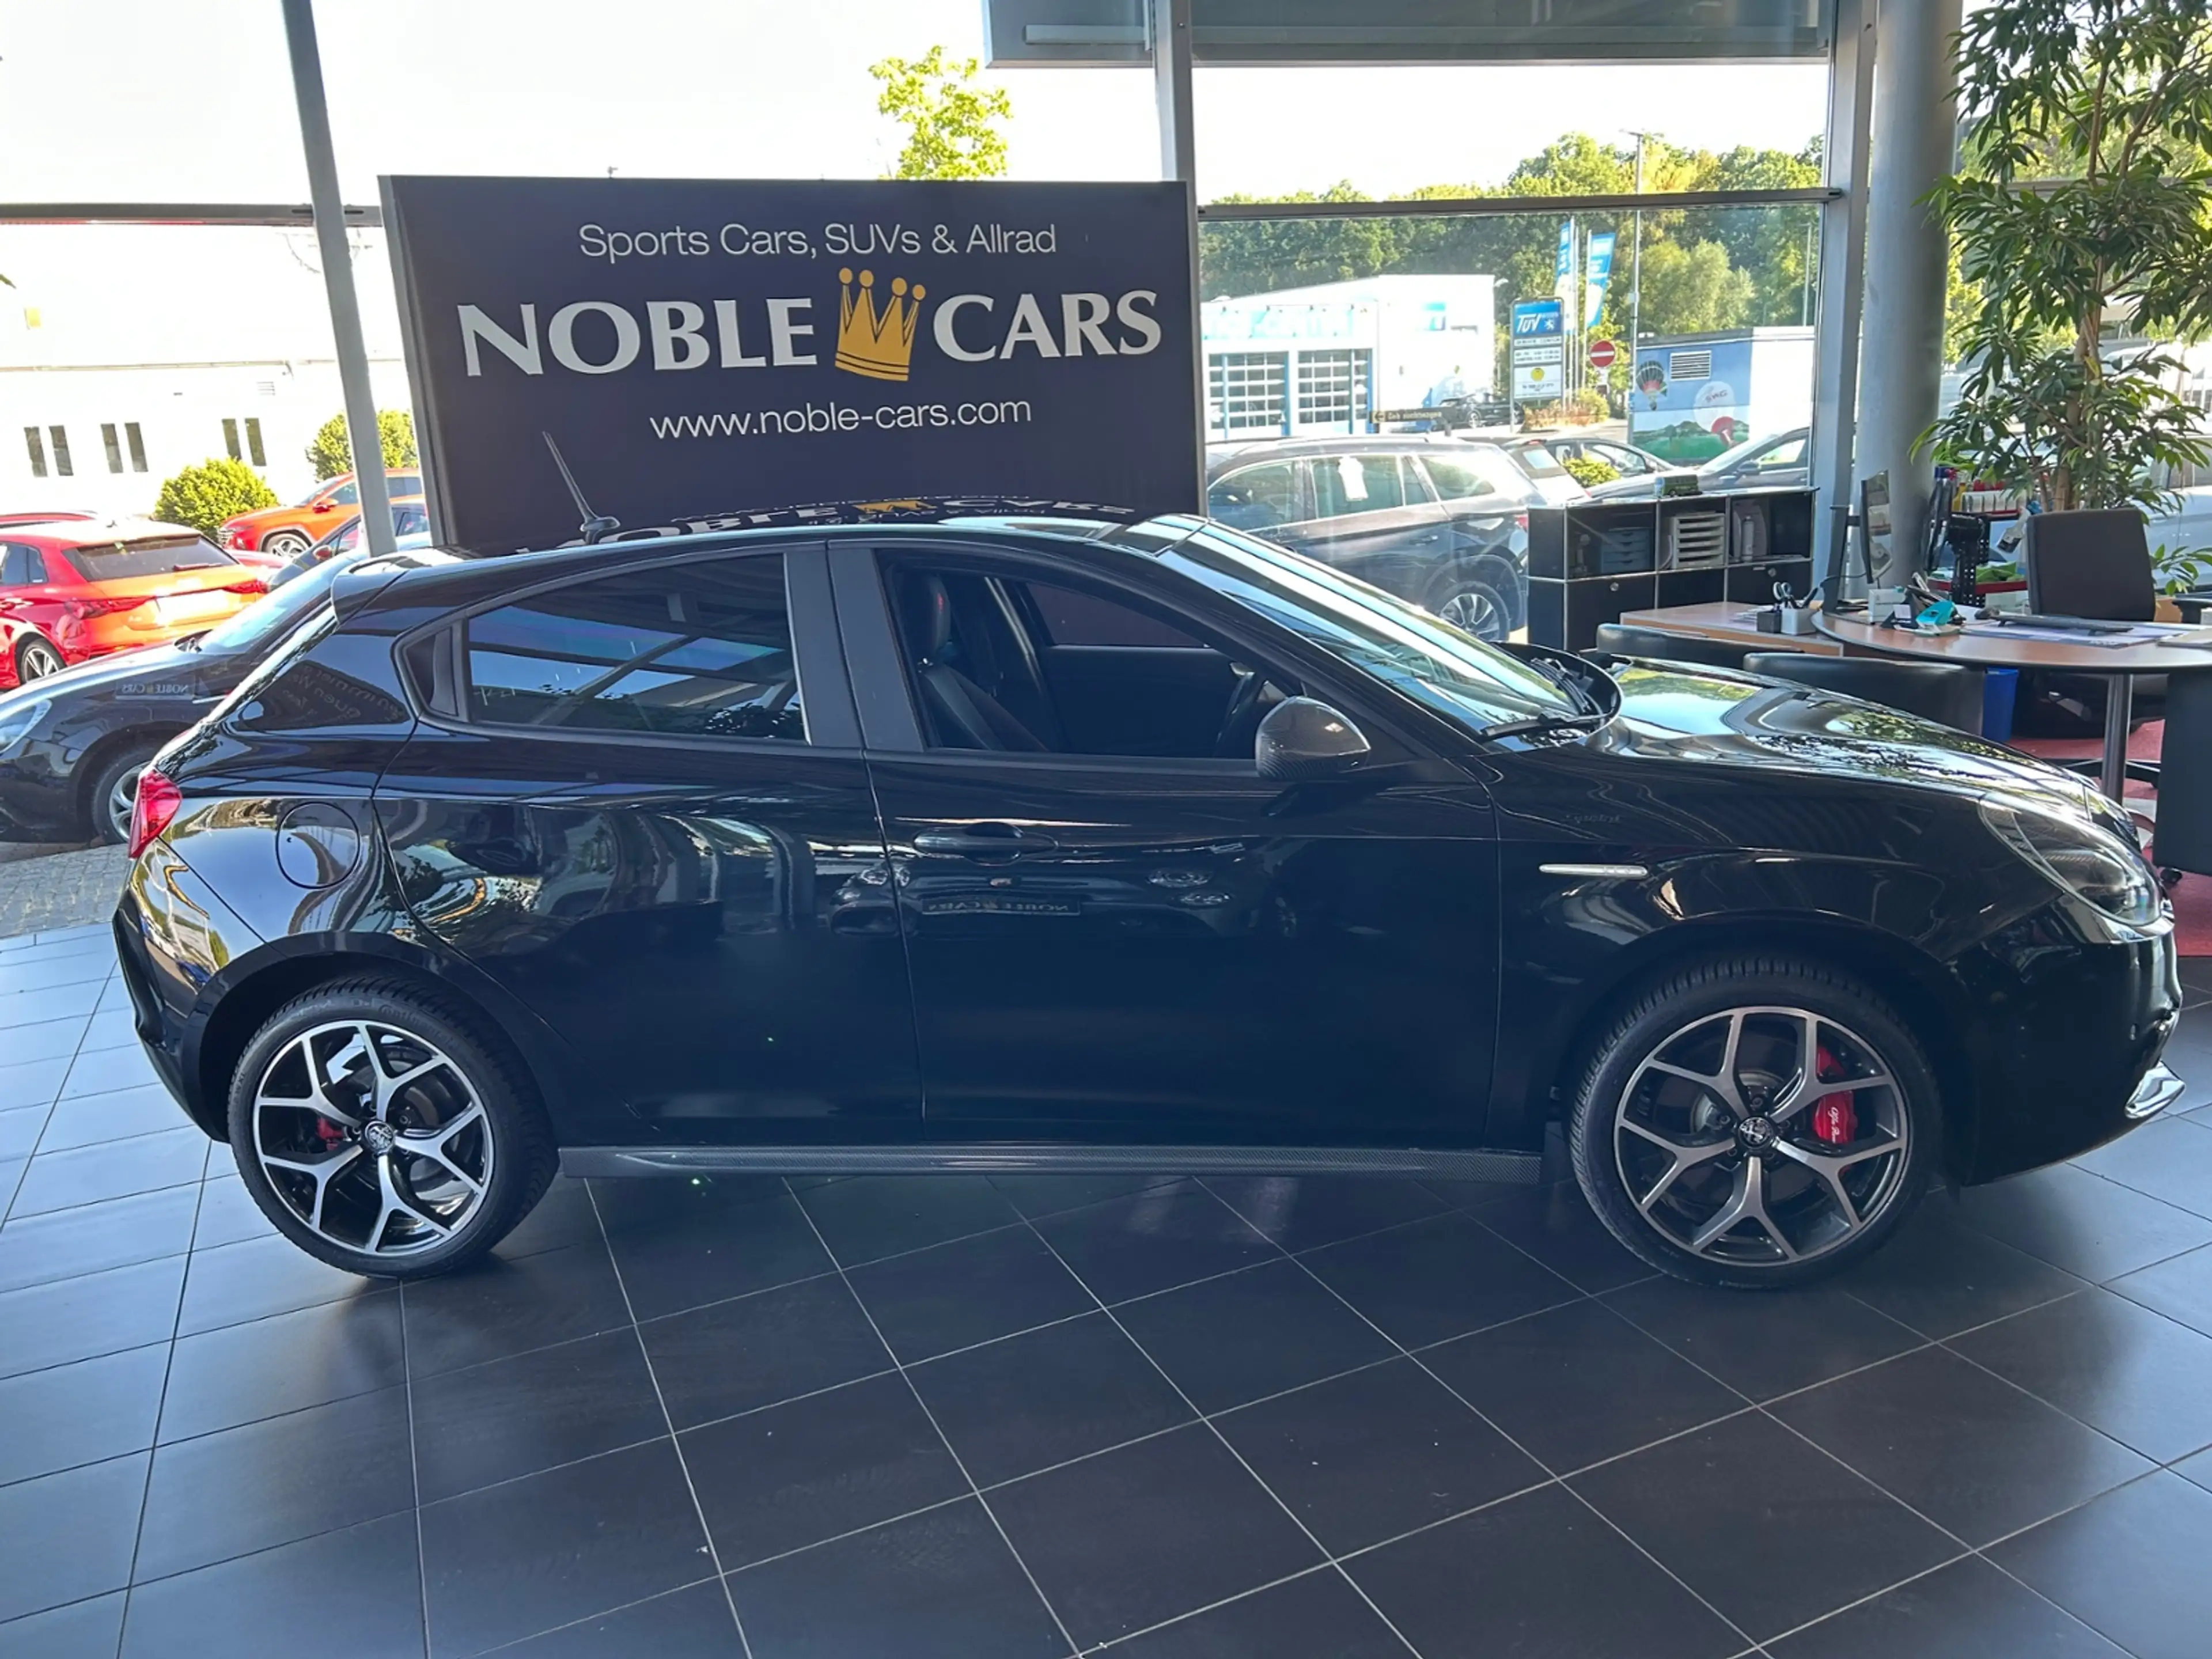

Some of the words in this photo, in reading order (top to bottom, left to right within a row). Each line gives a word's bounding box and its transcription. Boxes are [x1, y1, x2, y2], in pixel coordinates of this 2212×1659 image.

[578, 224, 710, 264] Sports
[720, 223, 817, 259] Cars,
[825, 222, 921, 254] SUVs
[931, 224, 959, 253] &
[966, 224, 1056, 253] Allrad
[457, 298, 817, 377] NOBLE
[933, 290, 1162, 362] CARS
[649, 400, 1032, 439] www.noble-cars.com
